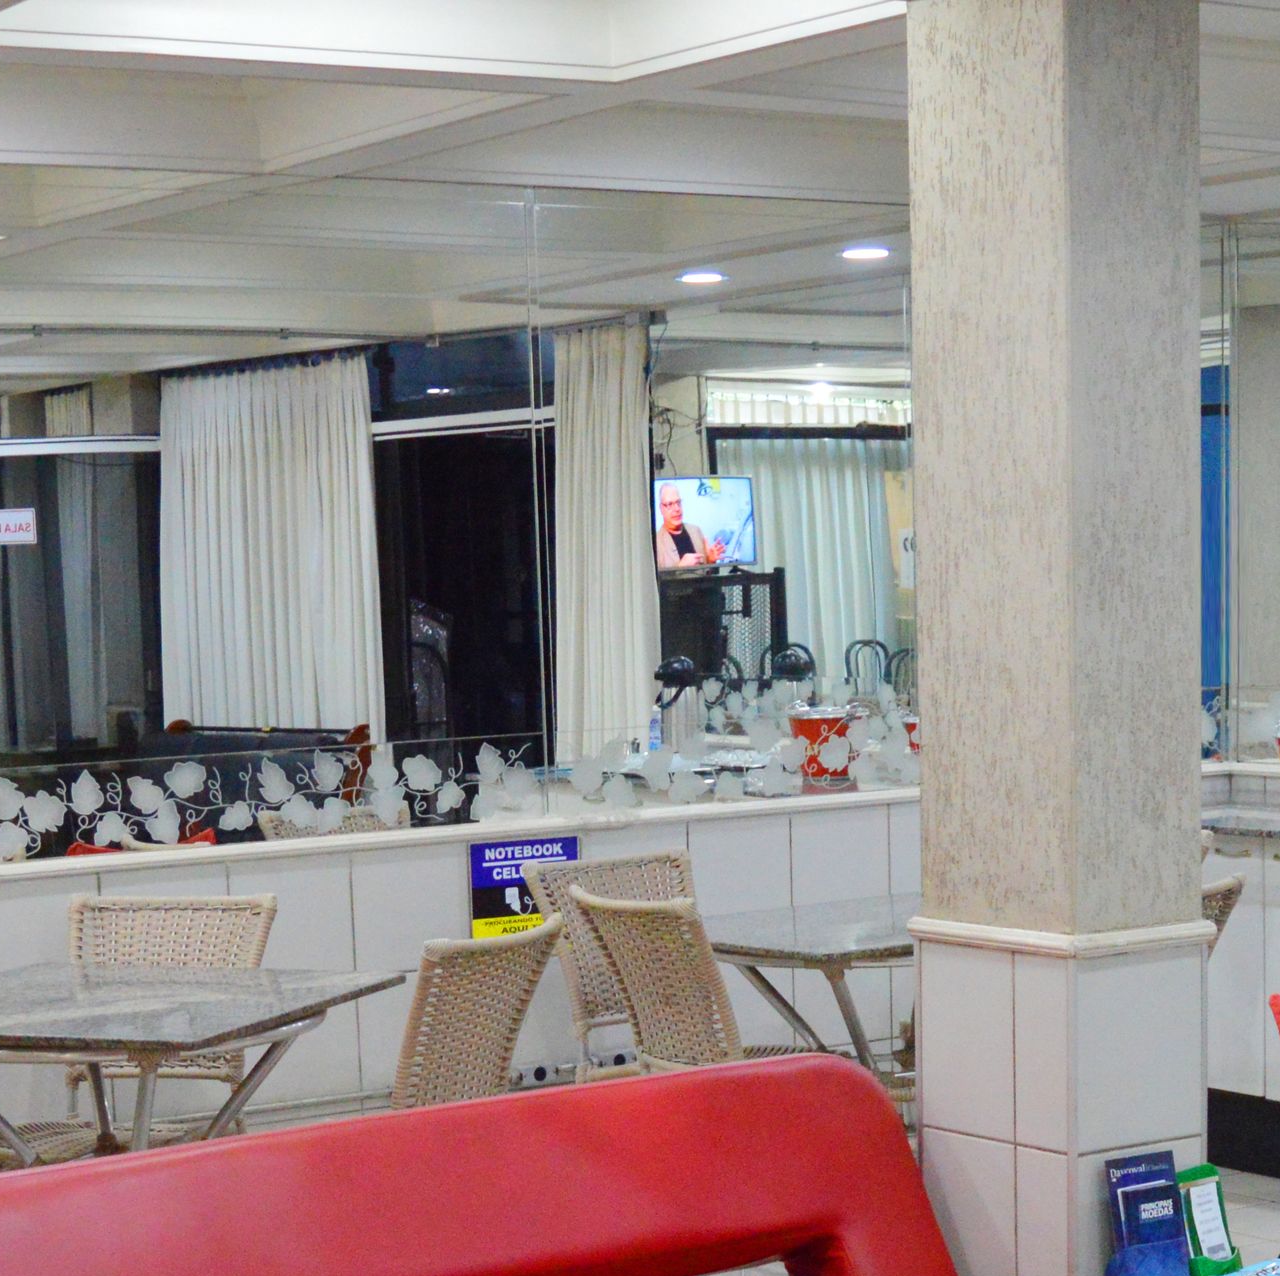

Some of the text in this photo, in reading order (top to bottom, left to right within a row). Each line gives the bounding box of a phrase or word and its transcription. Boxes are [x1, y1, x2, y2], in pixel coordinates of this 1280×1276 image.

[484, 843, 564, 860] NOTEBOOK
[501, 924, 529, 934] AQUI
[1141, 1205, 1174, 1219] MOEDAS
